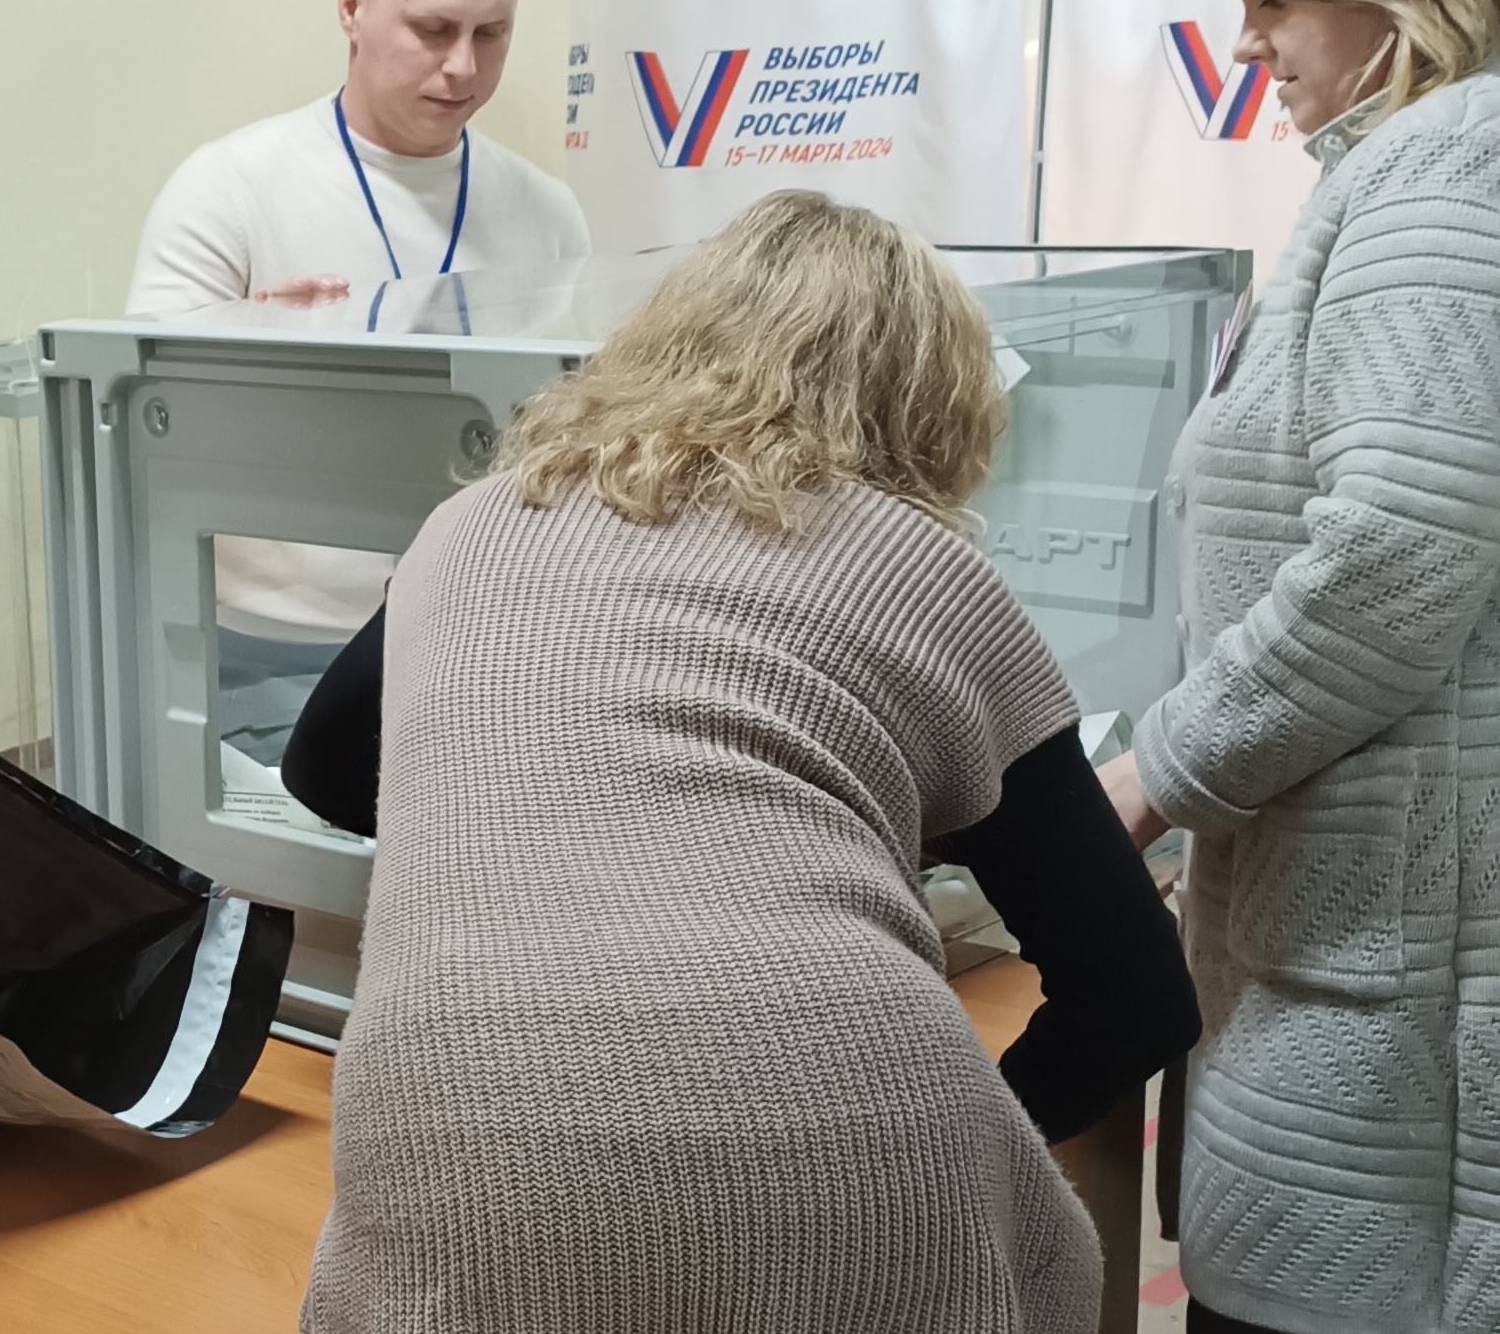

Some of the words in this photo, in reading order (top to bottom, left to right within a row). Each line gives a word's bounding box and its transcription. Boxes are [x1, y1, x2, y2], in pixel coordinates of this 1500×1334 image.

[763, 40, 885, 71] ВЫБОРЫ
[748, 72, 920, 105] ПРЕЗИДЕНТА
[734, 110, 847, 139] РОССИИ
[778, 142, 845, 164] МАРТА
[846, 136, 893, 161] 2024
